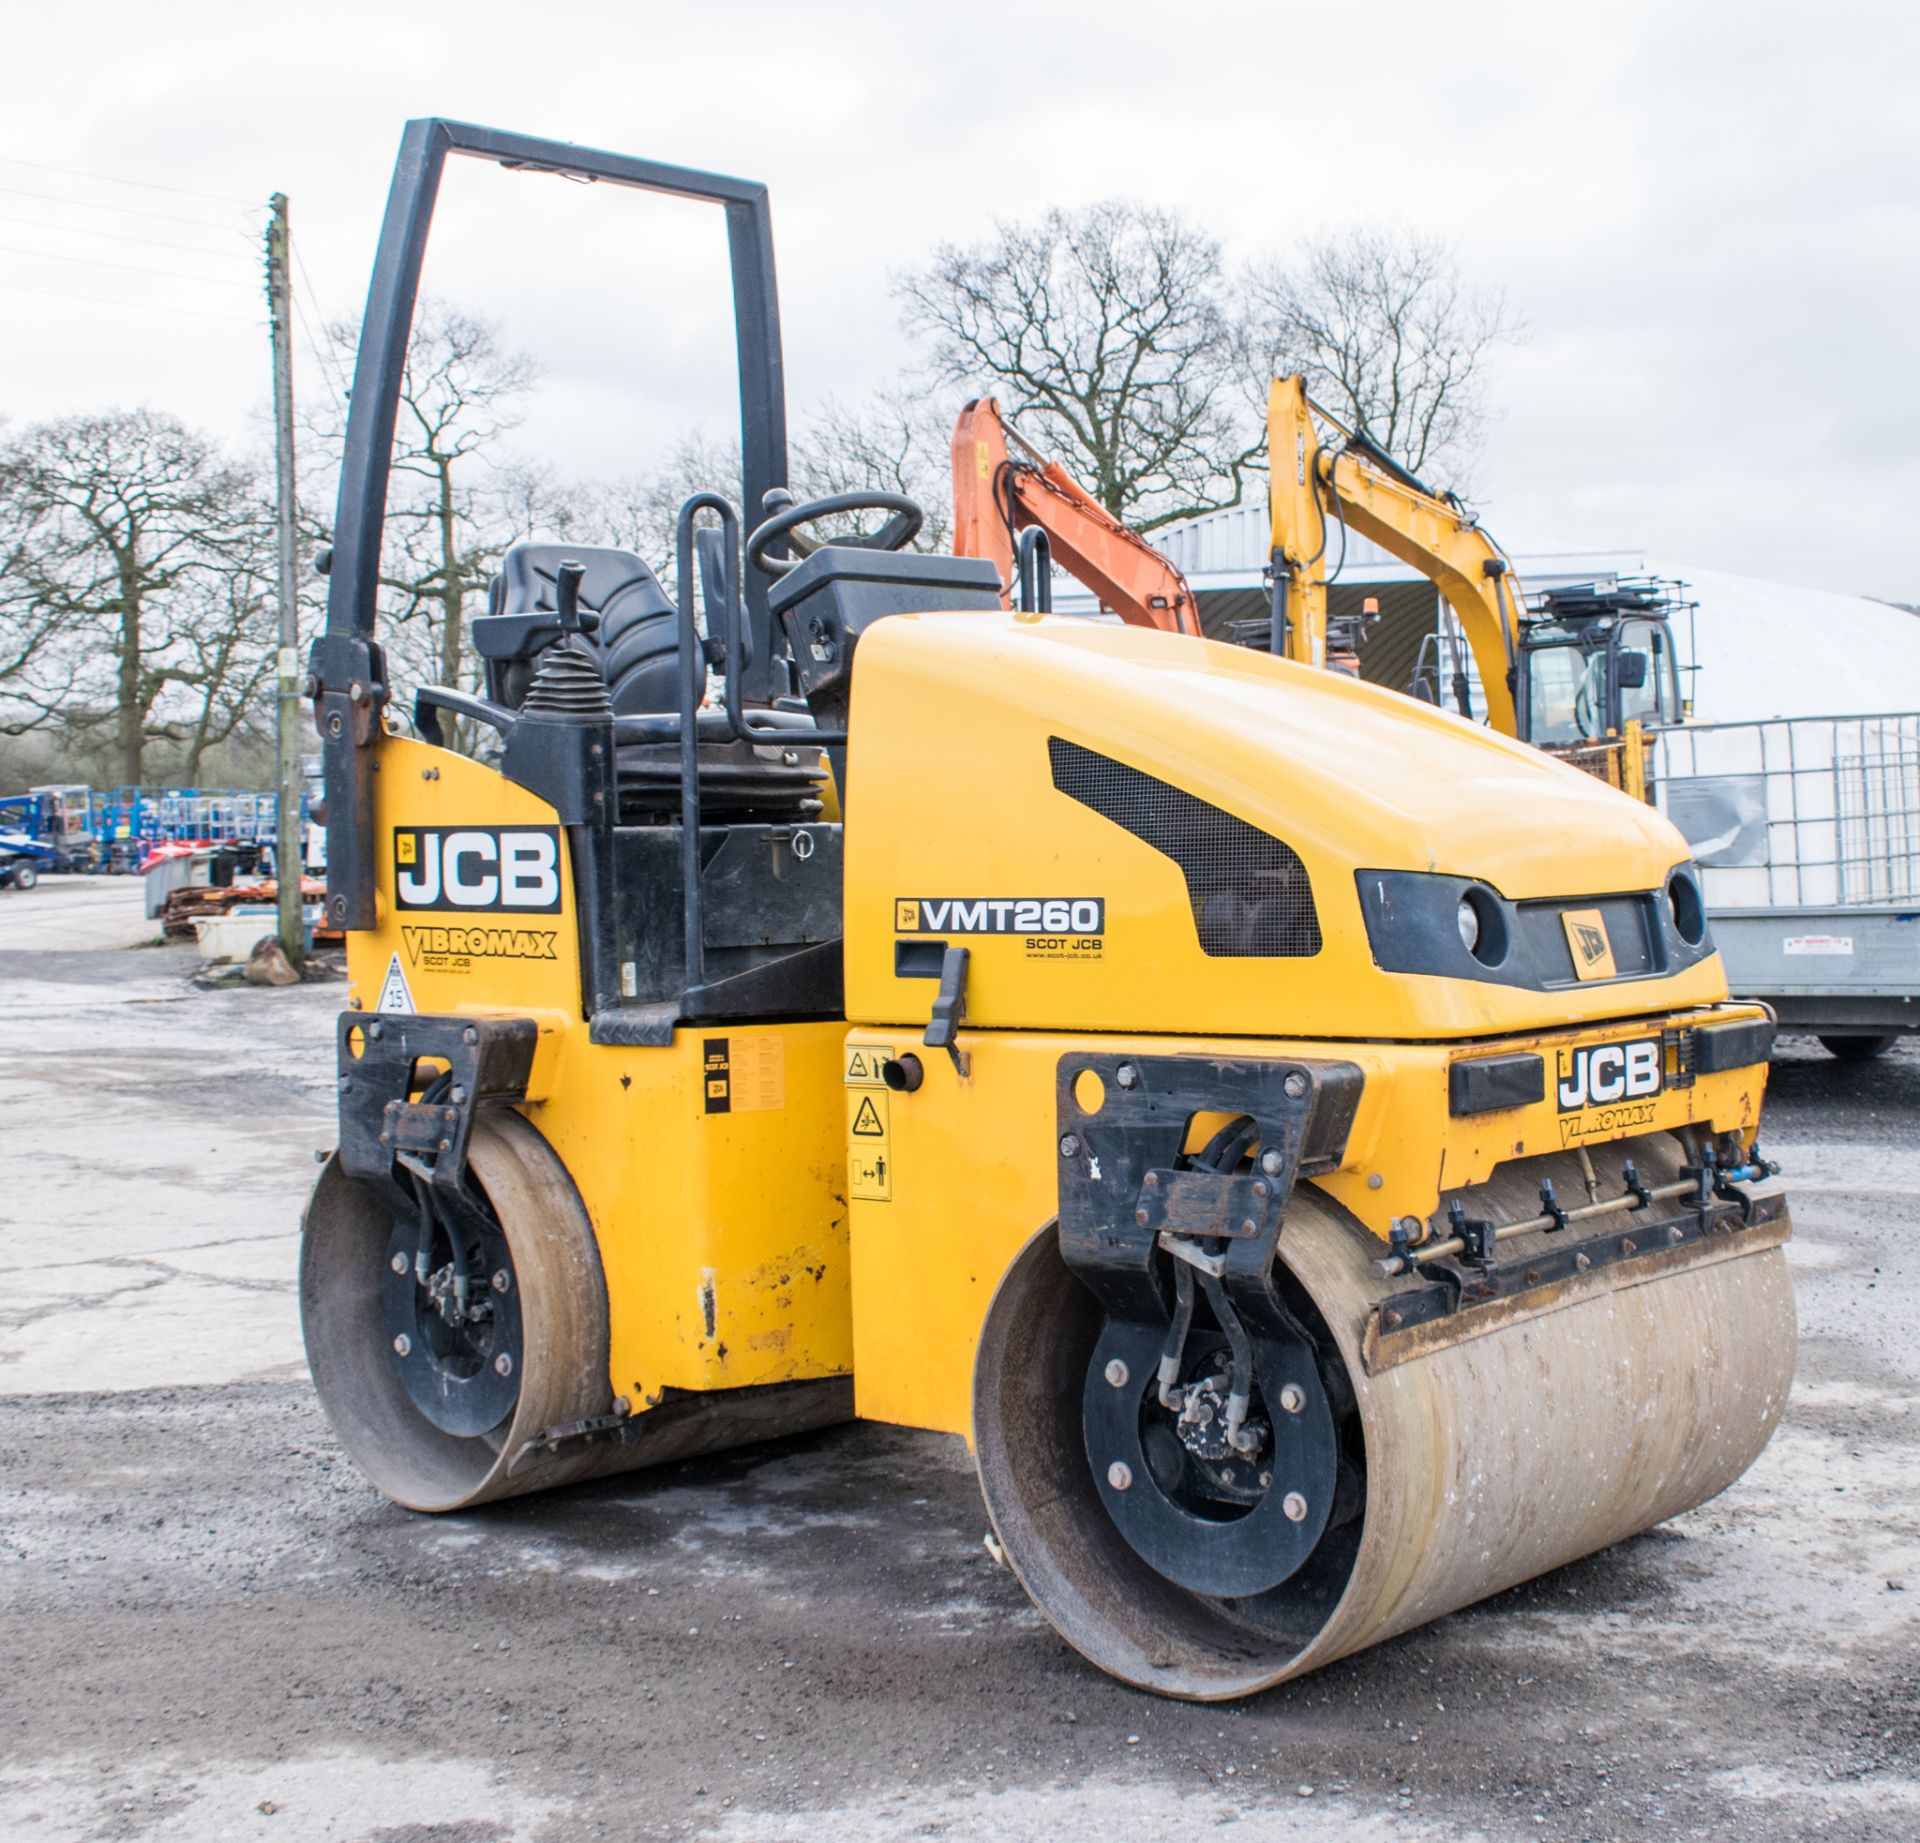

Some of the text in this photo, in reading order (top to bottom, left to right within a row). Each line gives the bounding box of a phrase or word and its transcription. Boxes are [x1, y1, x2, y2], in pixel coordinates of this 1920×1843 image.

[397, 832, 559, 906] JCB
[920, 900, 1099, 932] VMT260
[401, 925, 558, 968] VIBROMAX
[1026, 938, 1103, 950] SCOT JCB
[424, 956, 471, 967] SCOT JCB
[389, 990, 403, 1008] 15
[1559, 1041, 1660, 1107] JCB
